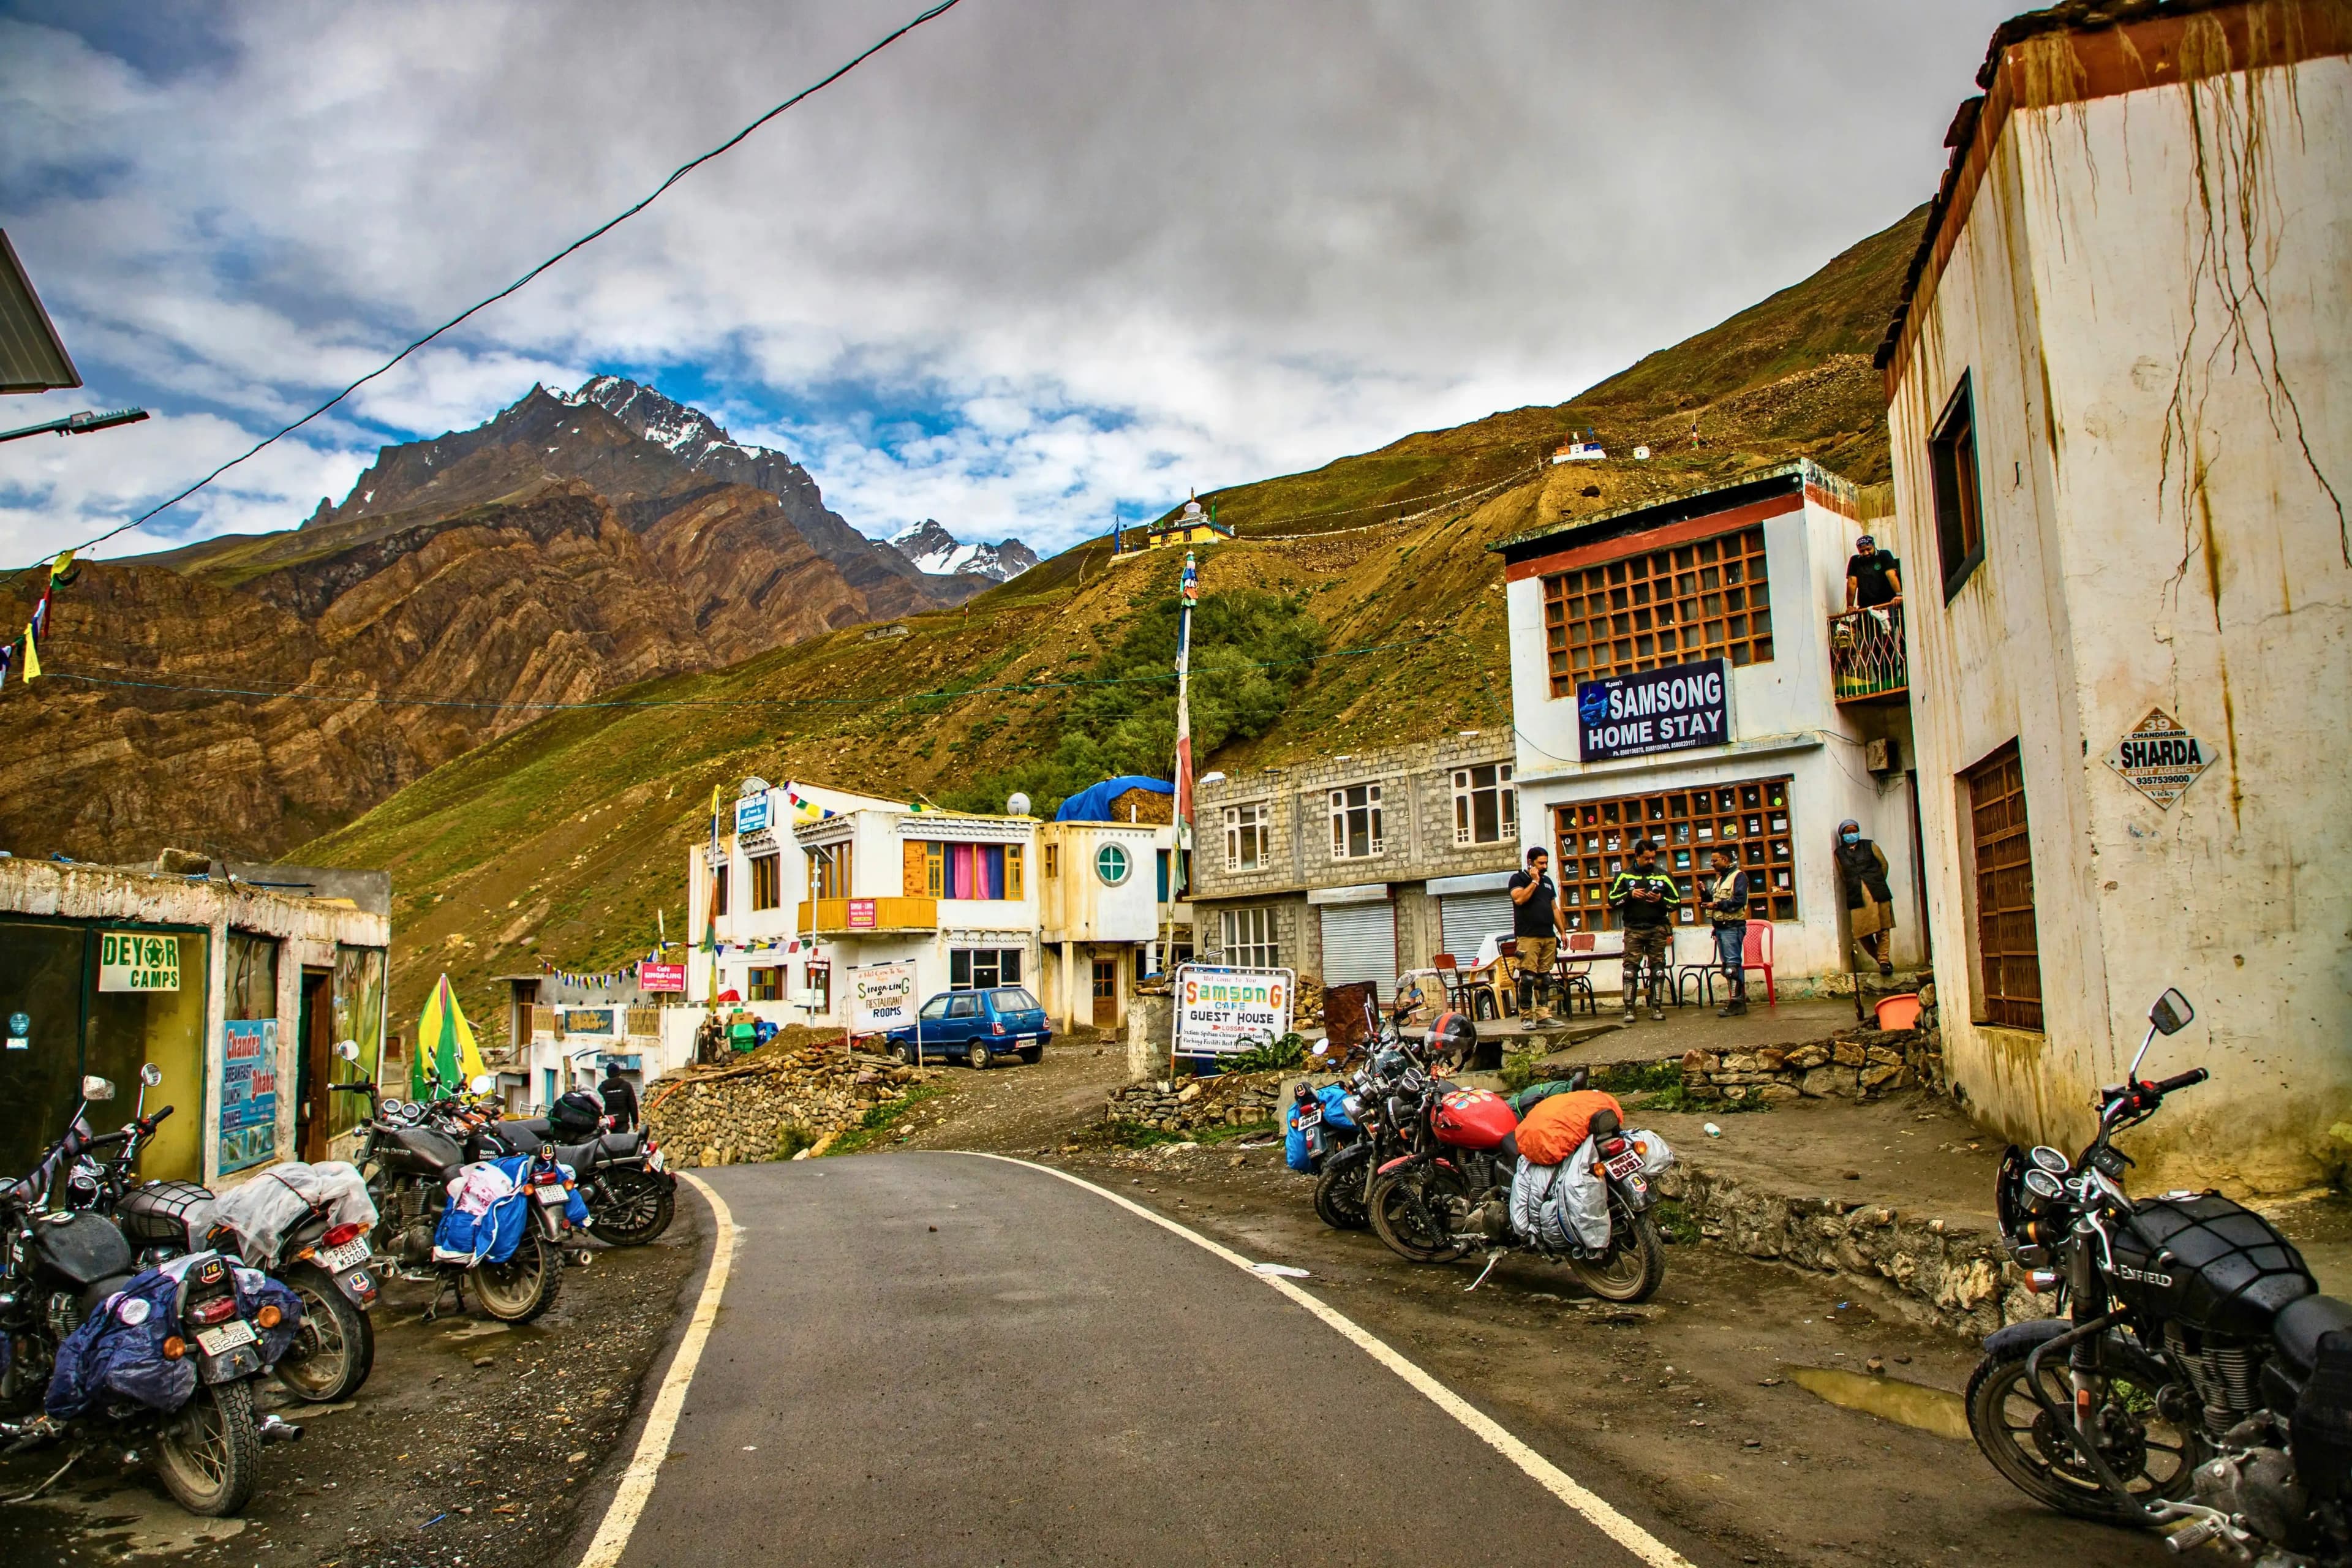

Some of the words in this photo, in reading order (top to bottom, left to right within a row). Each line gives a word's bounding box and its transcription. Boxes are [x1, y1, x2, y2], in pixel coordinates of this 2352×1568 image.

[1610, 673, 1722, 720] SAMSONG
[1588, 721, 1653, 750] HOME
[1660, 709, 1722, 740] STAY
[2144, 718, 2171, 732] 39
[2132, 730, 2187, 739] CHANDIGARH
[2120, 739, 2202, 769] SHARDA
[2125, 768, 2155, 777] FRUIT
[2157, 766, 2198, 775] AGENCY
[2136, 775, 2190, 785] 9357539000
[130, 970, 178, 987] CAMPS
[866, 995, 903, 1009] RESTAURANT
[1215, 1001, 1246, 1011] CAFE
[873, 1006, 902, 1018] ROOMS
[1190, 1011, 1231, 1022] GUEST
[1237, 1012, 1275, 1025] HOUSE
[226, 1028, 261, 1061] Chandra
[251, 1068, 274, 1102] Dhaba
[223, 1087, 241, 1107] LUNCH
[1611, 1158, 1642, 1177] 9091
[206, 1264, 218, 1274] 16
[2120, 1264, 2173, 1287] ENFIELD
[354, 1275, 361, 1284] 7
[210, 1332, 251, 1352] 8248
